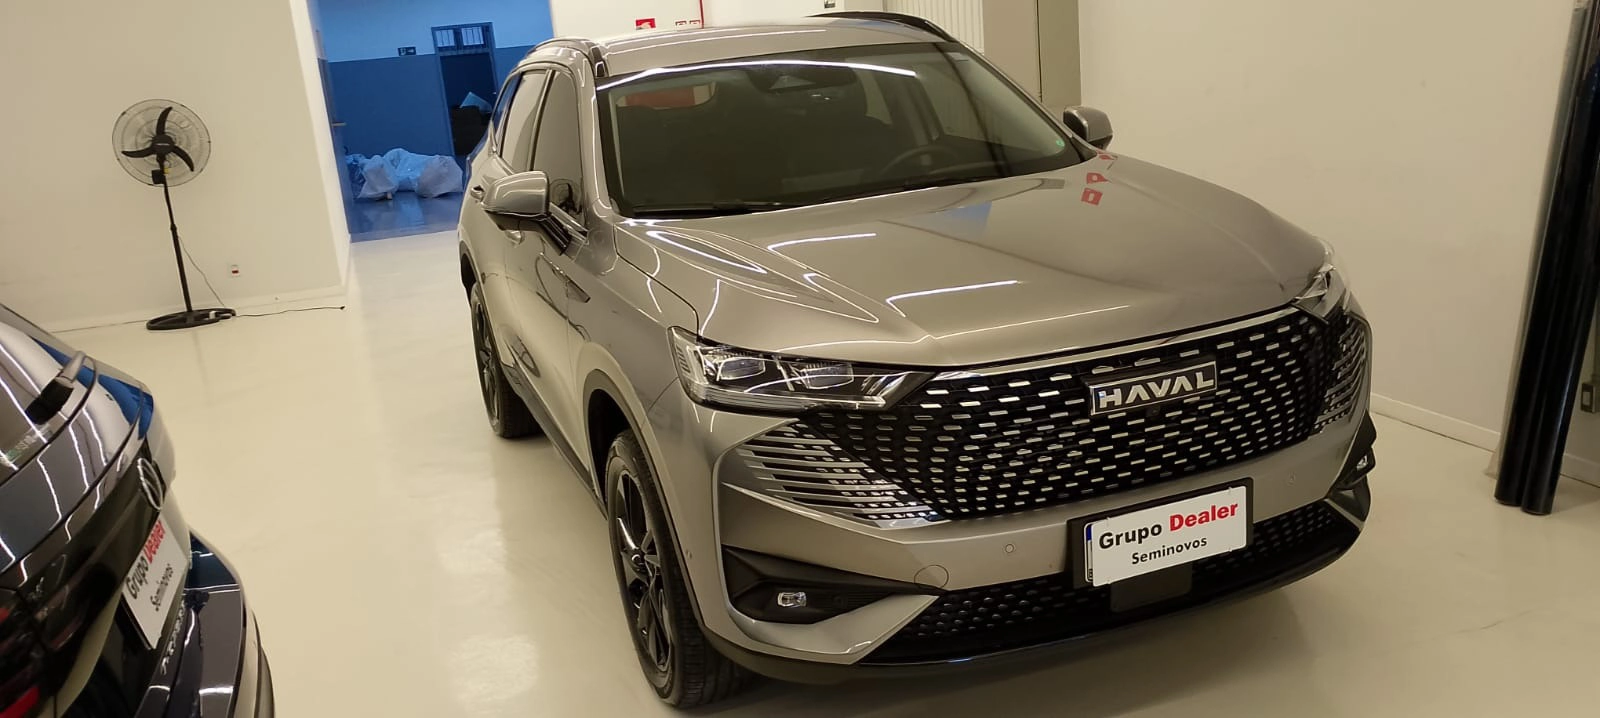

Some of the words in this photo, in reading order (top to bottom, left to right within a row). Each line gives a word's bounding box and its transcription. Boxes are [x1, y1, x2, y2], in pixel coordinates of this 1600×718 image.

[1099, 371, 1214, 409] HAVAL
[1099, 523, 1163, 550] Grupo
[1170, 503, 1238, 532] Dealer
[1131, 537, 1208, 565] Seminovos
[125, 555, 149, 600] Grupo
